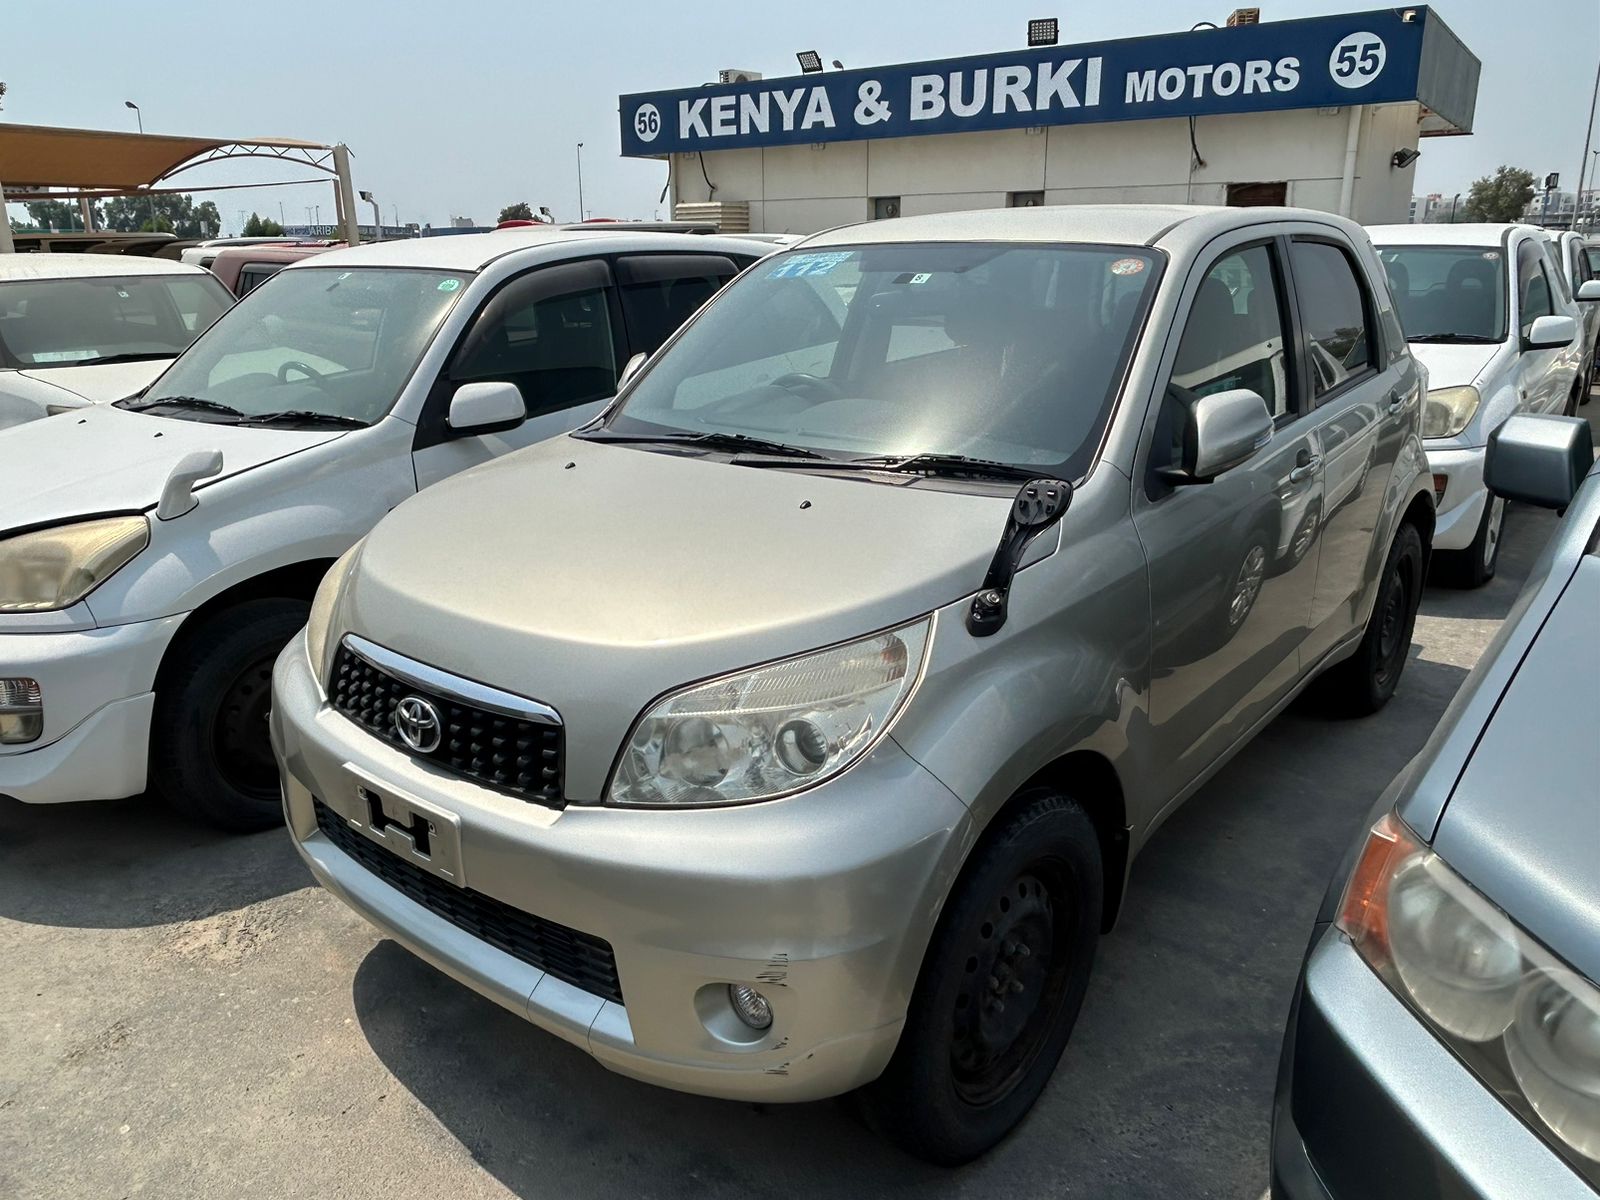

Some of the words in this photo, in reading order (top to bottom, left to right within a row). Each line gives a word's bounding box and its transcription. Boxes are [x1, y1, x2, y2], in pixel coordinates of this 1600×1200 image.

[1336, 42, 1381, 77] 55
[678, 87, 836, 140] KENYA
[854, 80, 892, 126] &
[910, 56, 1103, 121] BURKI
[1125, 56, 1300, 104] MOTORS
[637, 110, 659, 134] 56
